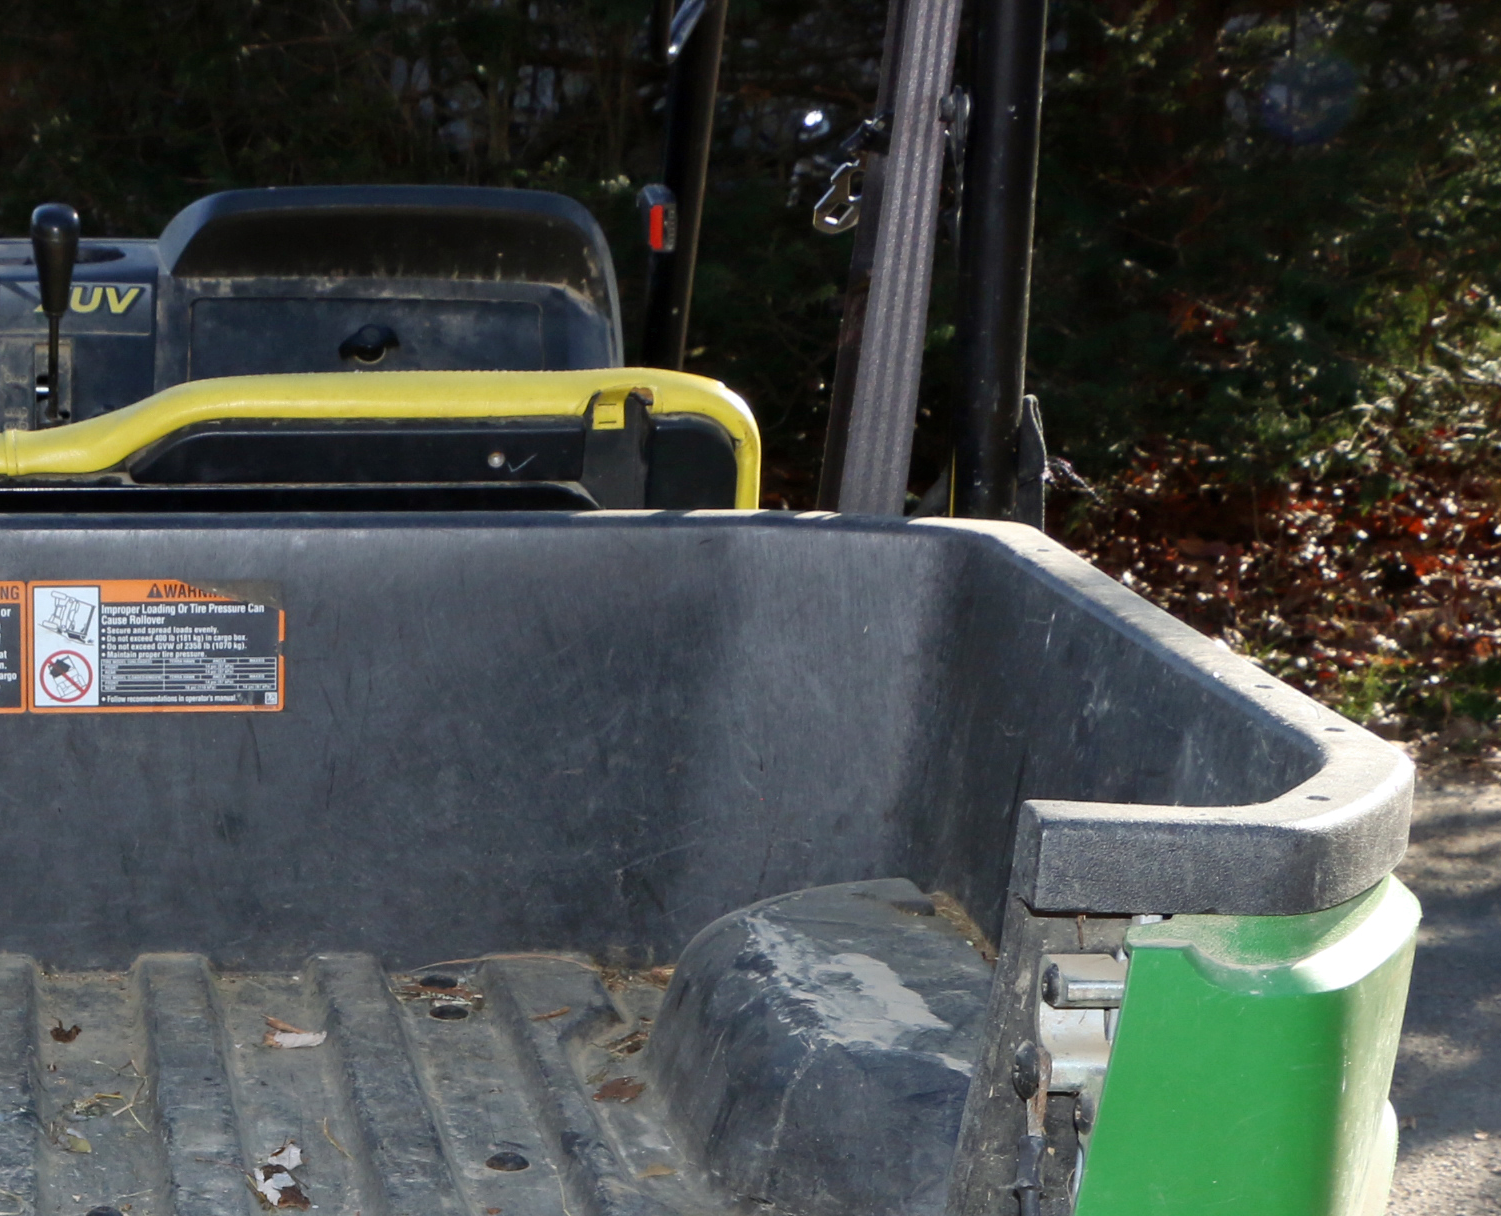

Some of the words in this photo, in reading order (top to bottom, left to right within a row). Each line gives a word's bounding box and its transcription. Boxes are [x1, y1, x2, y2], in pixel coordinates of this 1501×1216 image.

[0, 608, 11, 617] or
[101, 604, 140, 616] Improper
[141, 604, 175, 616] Loading
[177, 603, 188, 614] Or
[191, 603, 207, 614] Tire
[209, 603, 246, 614] Pressure
[247, 603, 265, 613] Can
[101, 615, 127, 625] Cause
[129, 614, 165, 625] Rollover
[107, 626, 131, 634] Secure
[133, 626, 146, 634] and
[147, 626, 171, 635] spread
[173, 626, 193, 634] loads
[194, 626, 219, 634] evenly.
[107, 634, 117, 642] Do
[129, 634, 153, 642] exceed
[213, 634, 233, 642] cargo
[175, 642, 183, 650] of
